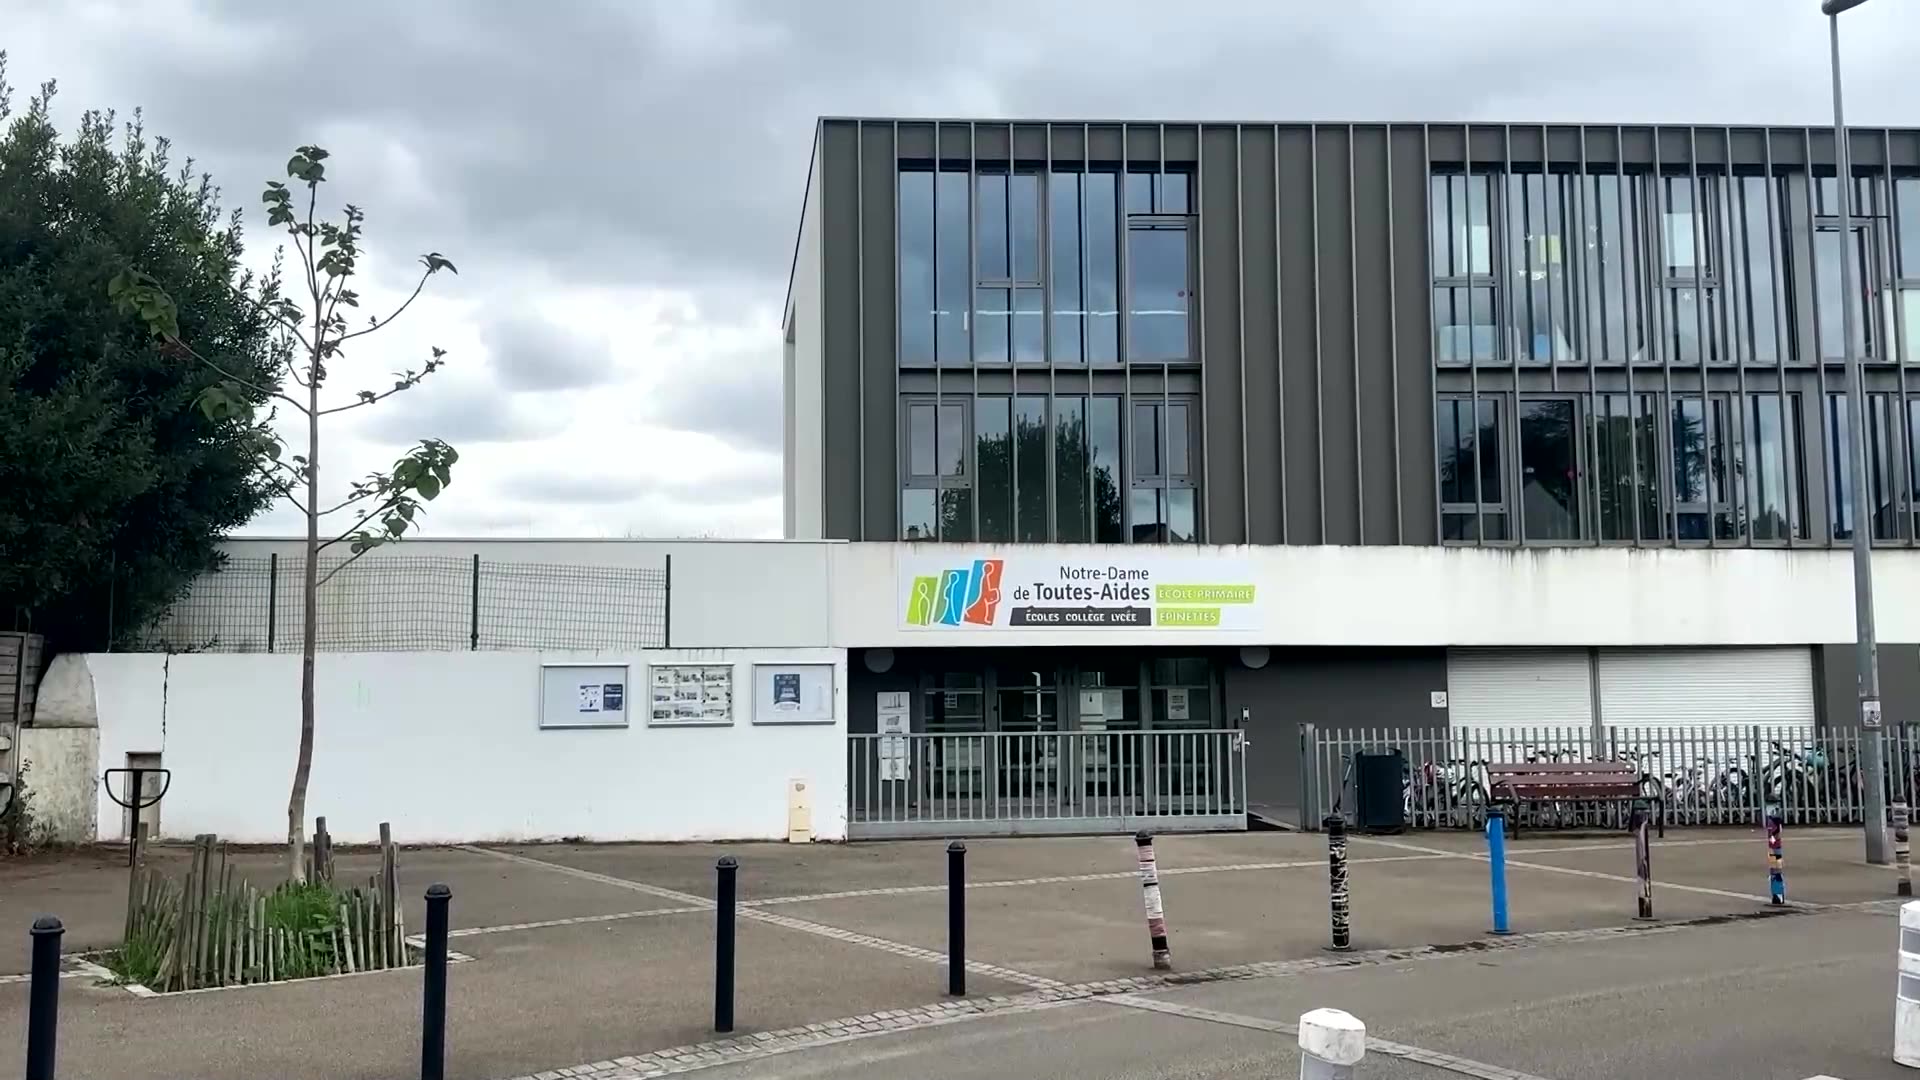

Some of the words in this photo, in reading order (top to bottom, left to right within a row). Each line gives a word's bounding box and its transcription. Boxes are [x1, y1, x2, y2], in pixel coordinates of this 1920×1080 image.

[1060, 565, 1149, 580] Notre-Dame
[1013, 585, 1030, 600] de
[1033, 582, 1150, 600] Toutes-Aides
[1197, 589, 1251, 599] PRIMAIRE
[1025, 609, 1060, 622] ÉCOLES
[1065, 609, 1105, 622] COLLÈGE
[1111, 609, 1137, 622] LYCÉE
